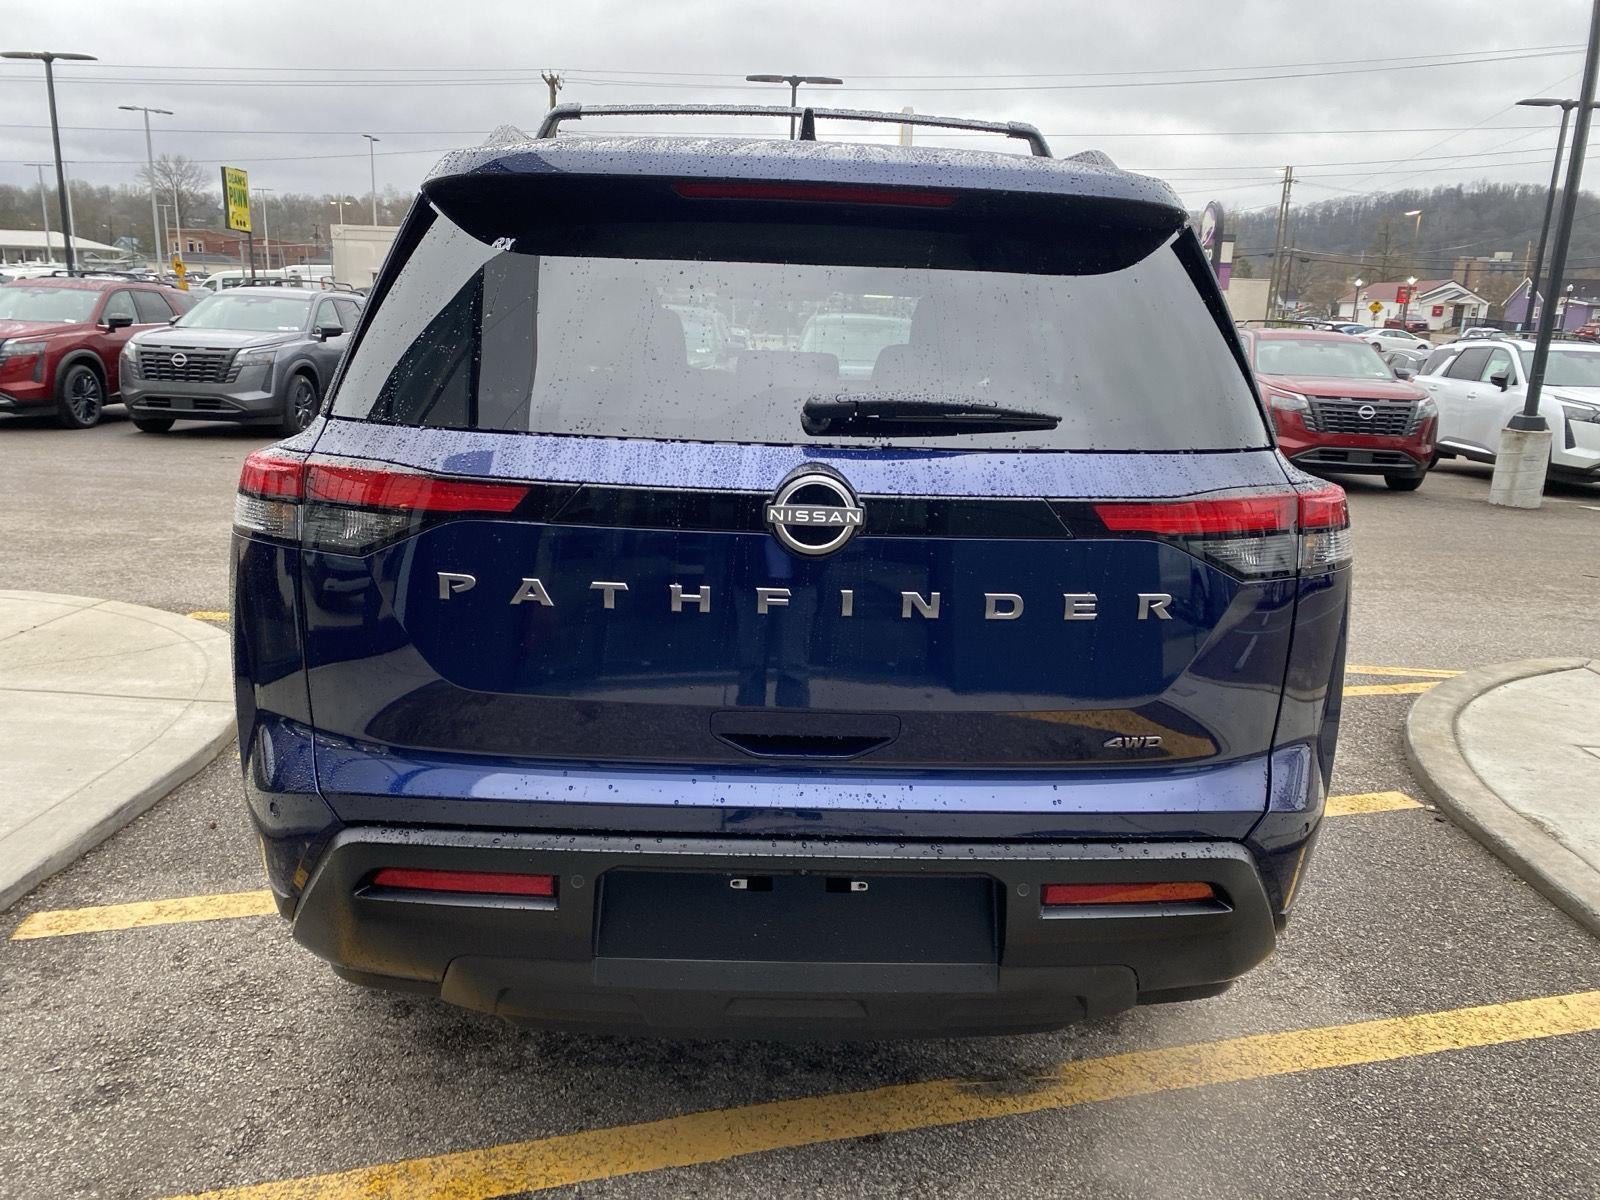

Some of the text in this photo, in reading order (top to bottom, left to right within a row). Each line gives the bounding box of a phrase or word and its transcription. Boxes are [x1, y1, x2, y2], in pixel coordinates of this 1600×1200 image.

[228, 185, 248, 208] PAWN
[769, 509, 861, 523] NISSAN
[437, 571, 1173, 621] PATHFINDER
[1103, 735, 1163, 749] 4WD
